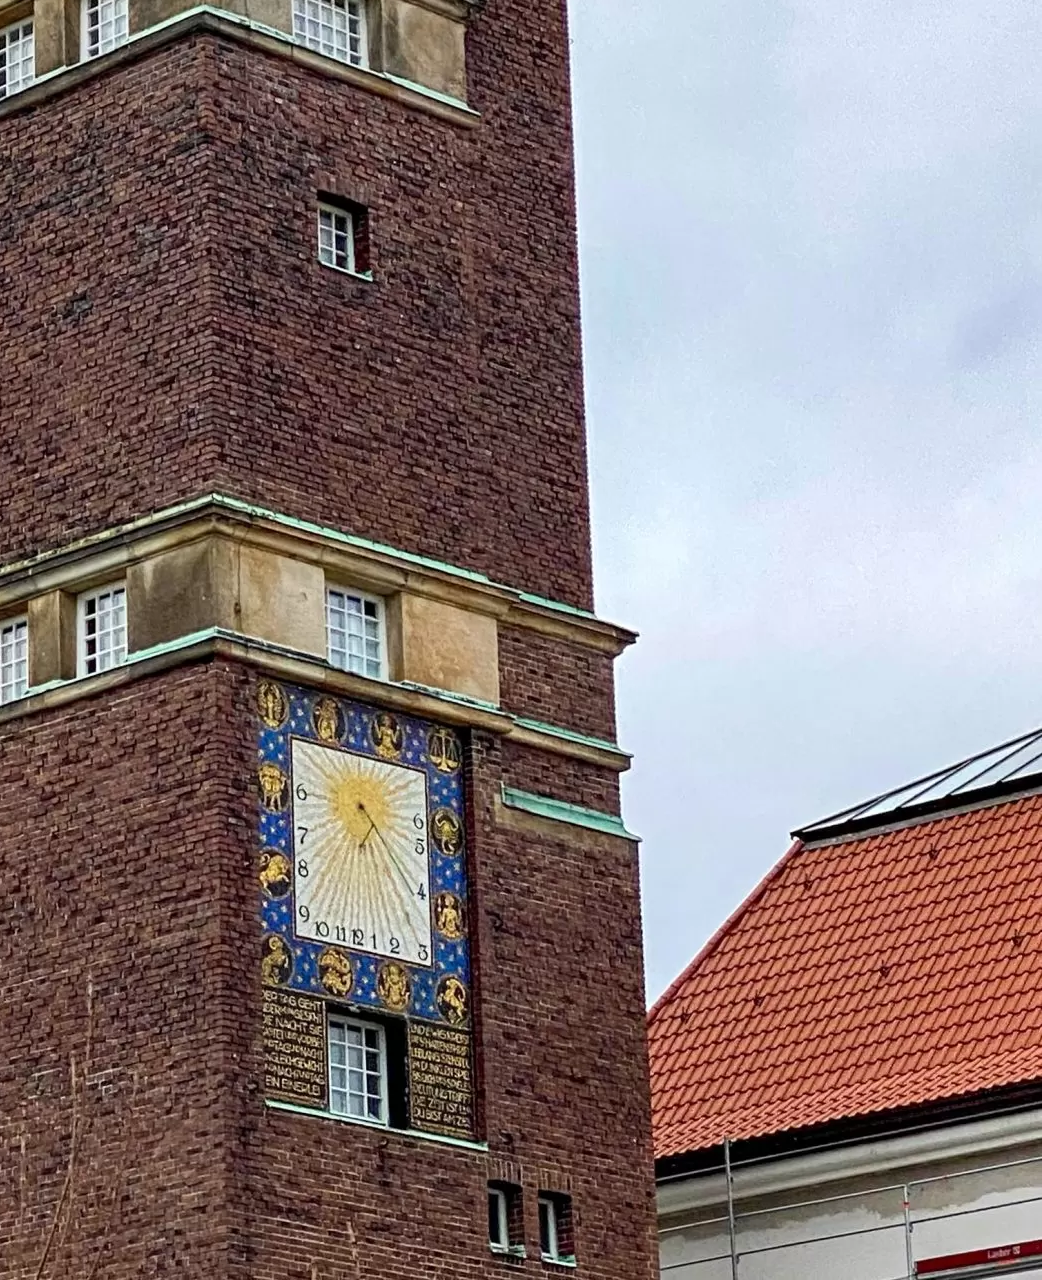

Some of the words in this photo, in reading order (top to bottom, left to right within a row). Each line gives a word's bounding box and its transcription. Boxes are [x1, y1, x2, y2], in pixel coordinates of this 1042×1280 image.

[296, 783, 307, 801] 6
[413, 814, 424, 829] 6
[298, 827, 308, 845] 7
[414, 838, 424, 855] 5
[298, 859, 309, 877] 8
[416, 883, 427, 901] 4
[299, 905, 310, 922] 9
[315, 921, 330, 937] 10
[335, 926, 347, 942] 11
[352, 929, 364, 946] 12
[370, 934, 377, 950] 1
[390, 938, 401, 954] 2
[418, 945, 428, 961] 3
[298, 997, 322, 1012] GEHT
[275, 1017, 308, 1033] NACHT
[309, 1024, 323, 1037] SIE
